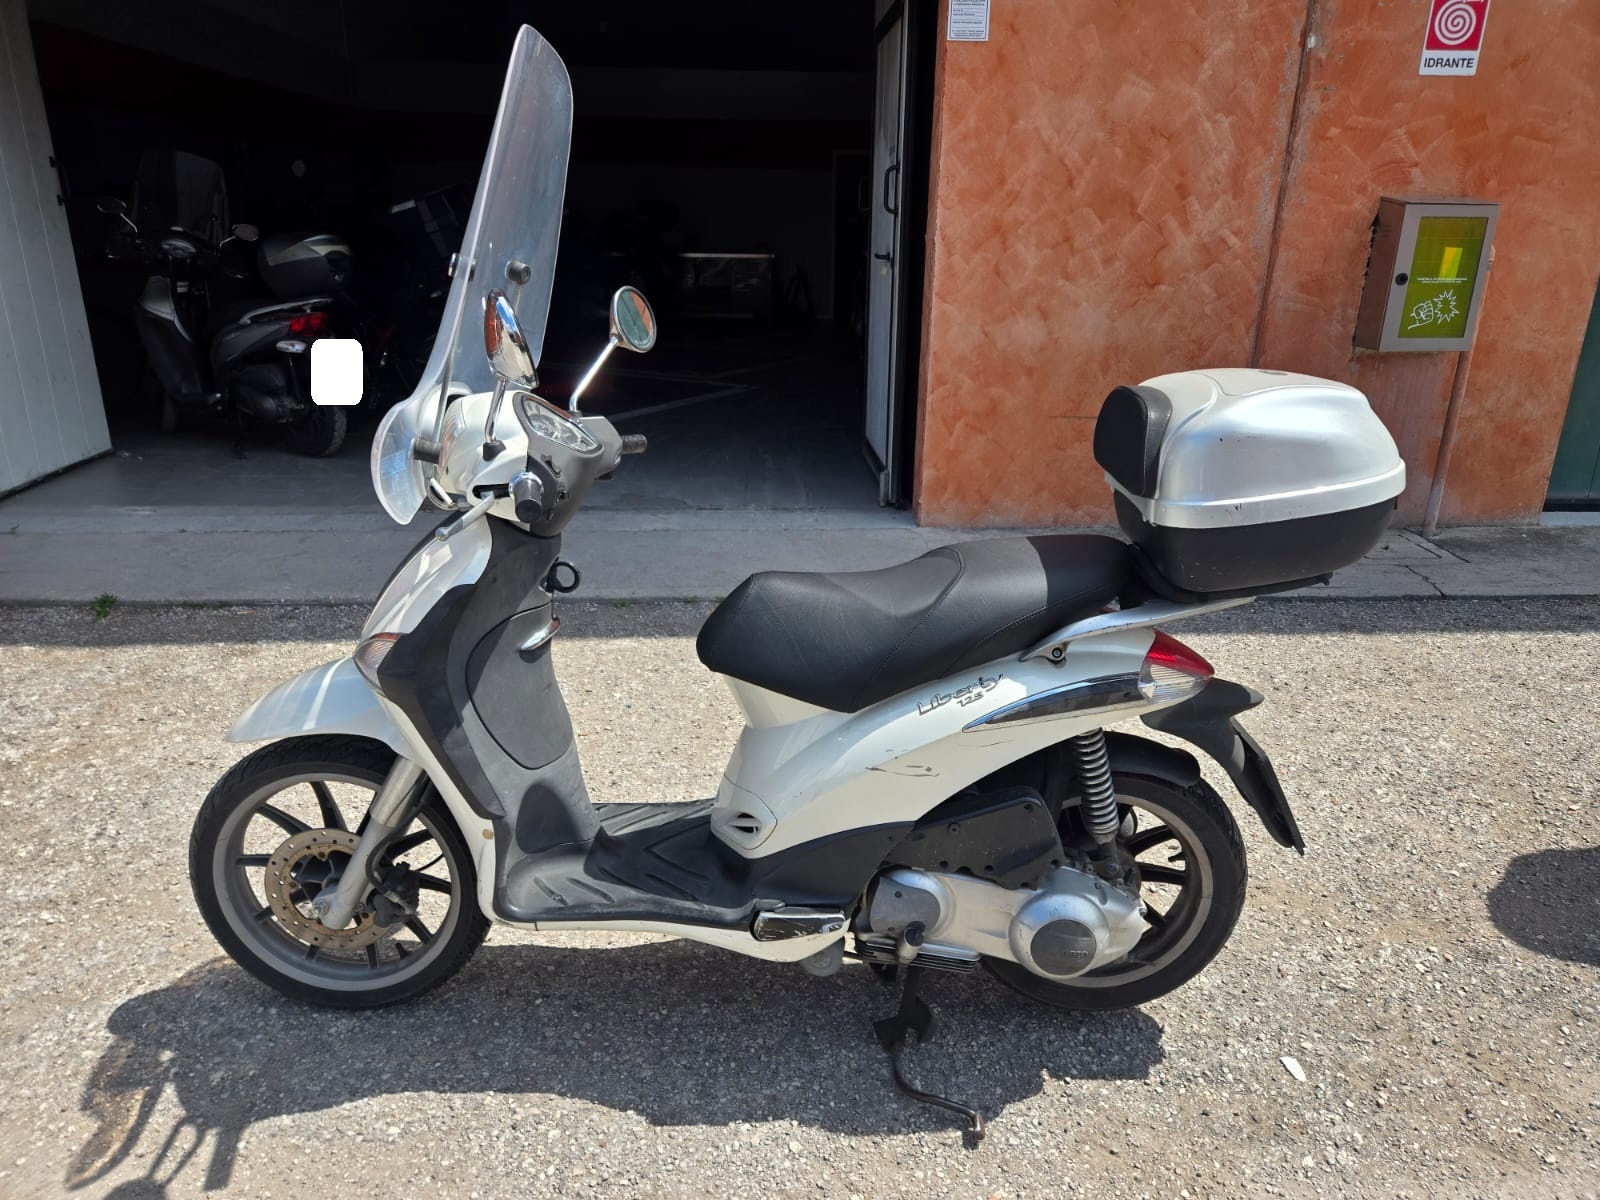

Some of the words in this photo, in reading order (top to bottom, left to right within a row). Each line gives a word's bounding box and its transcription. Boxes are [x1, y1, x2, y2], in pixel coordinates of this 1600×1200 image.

[1423, 57, 1475, 68] IDRANTE
[917, 673, 1003, 715] Liberty
[956, 691, 984, 707] 125
